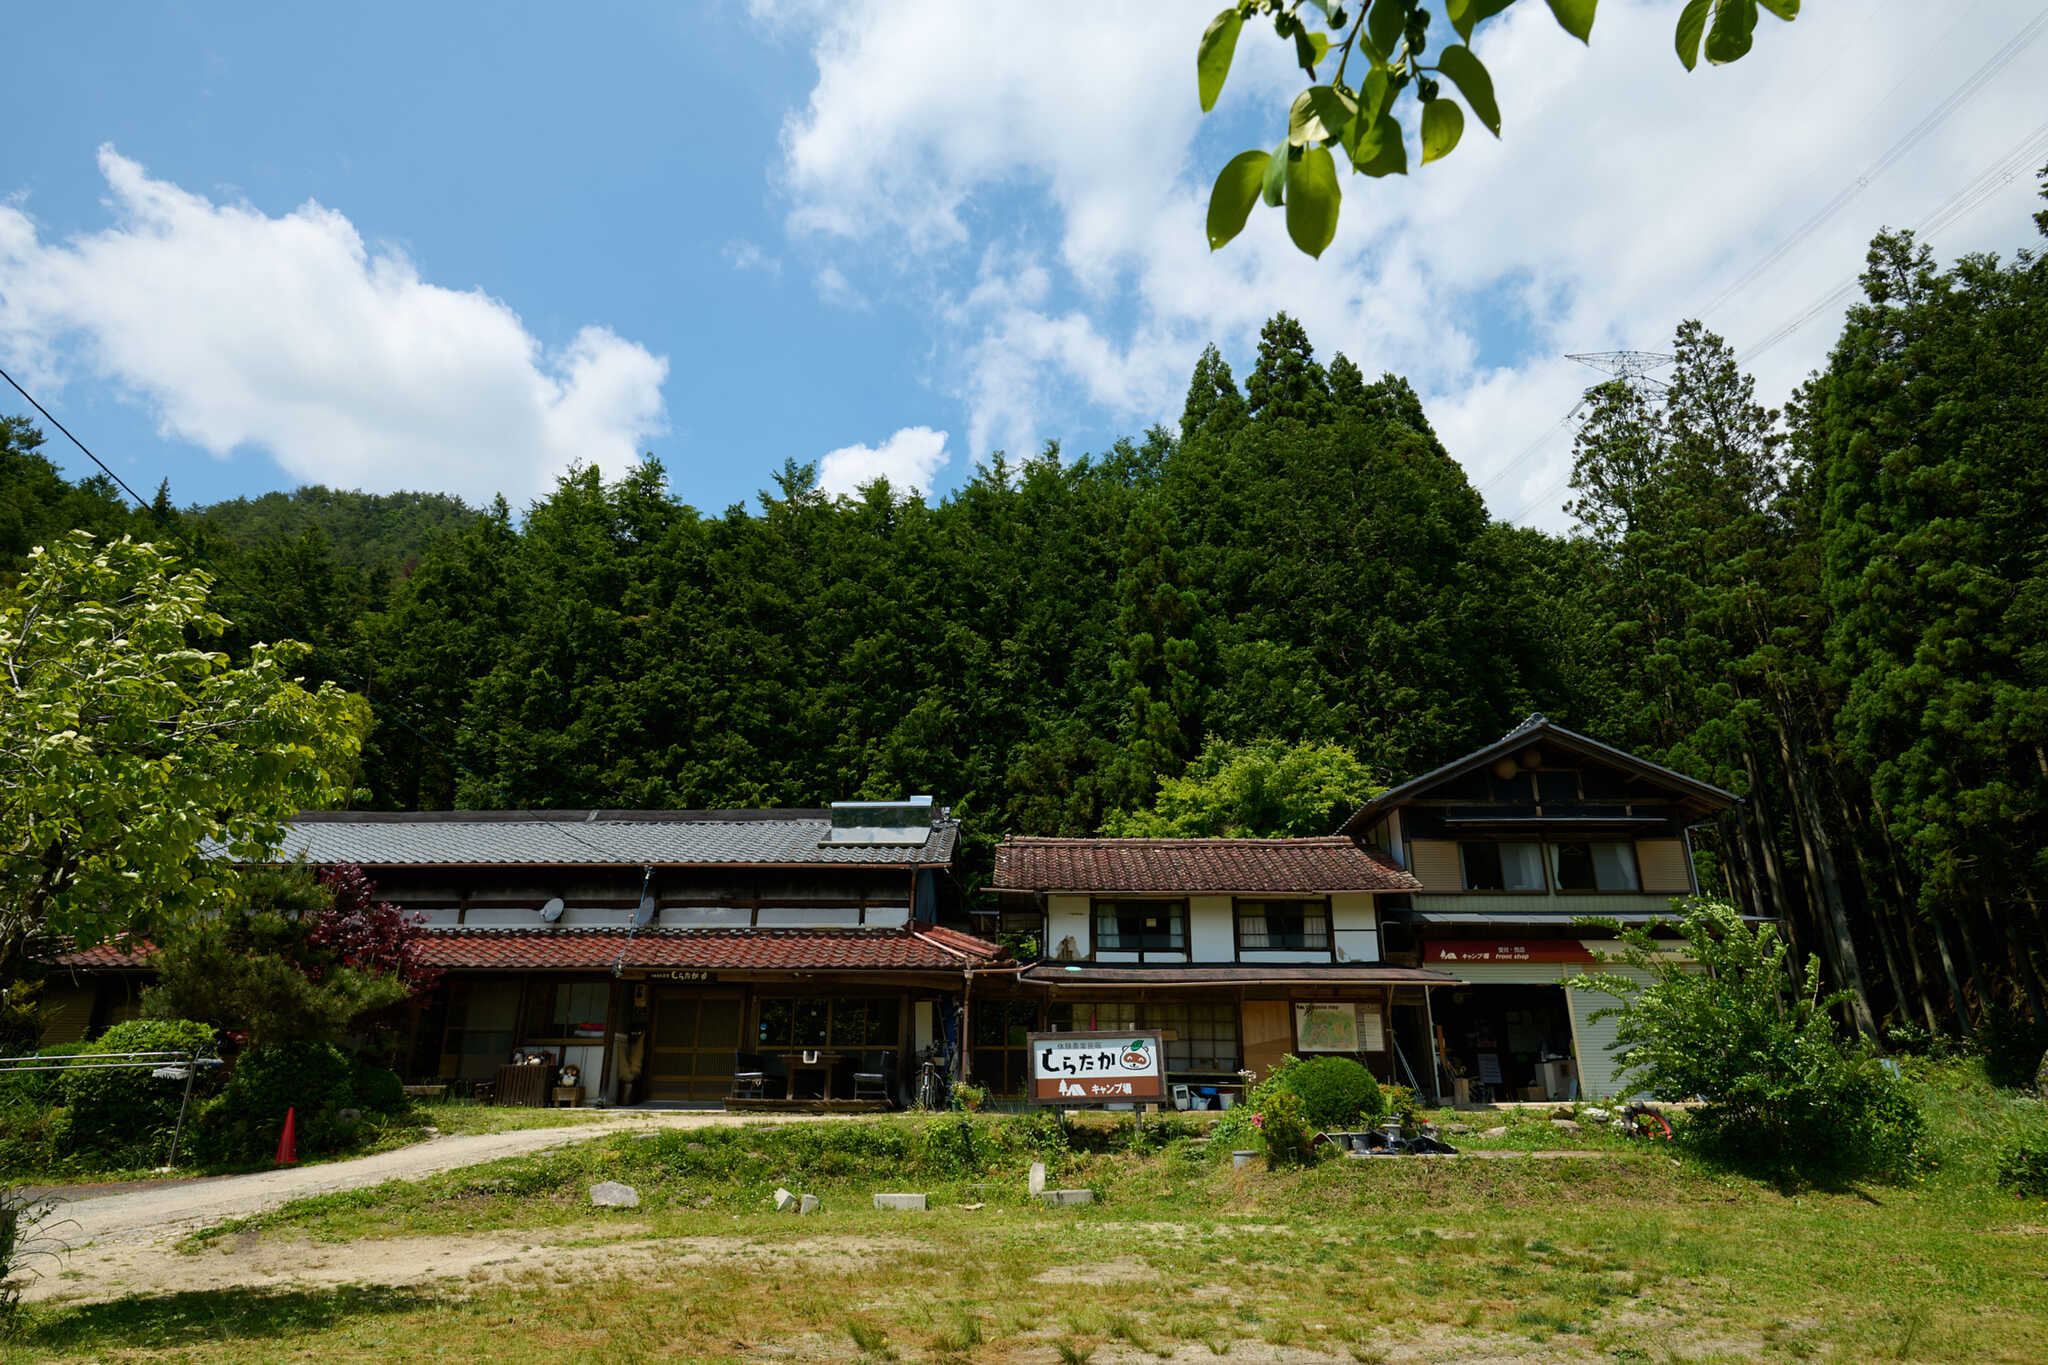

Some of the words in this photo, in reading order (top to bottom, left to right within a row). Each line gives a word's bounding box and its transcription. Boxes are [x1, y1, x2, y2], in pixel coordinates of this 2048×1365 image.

[1091, 1082, 1132, 1095] キャンプ場
